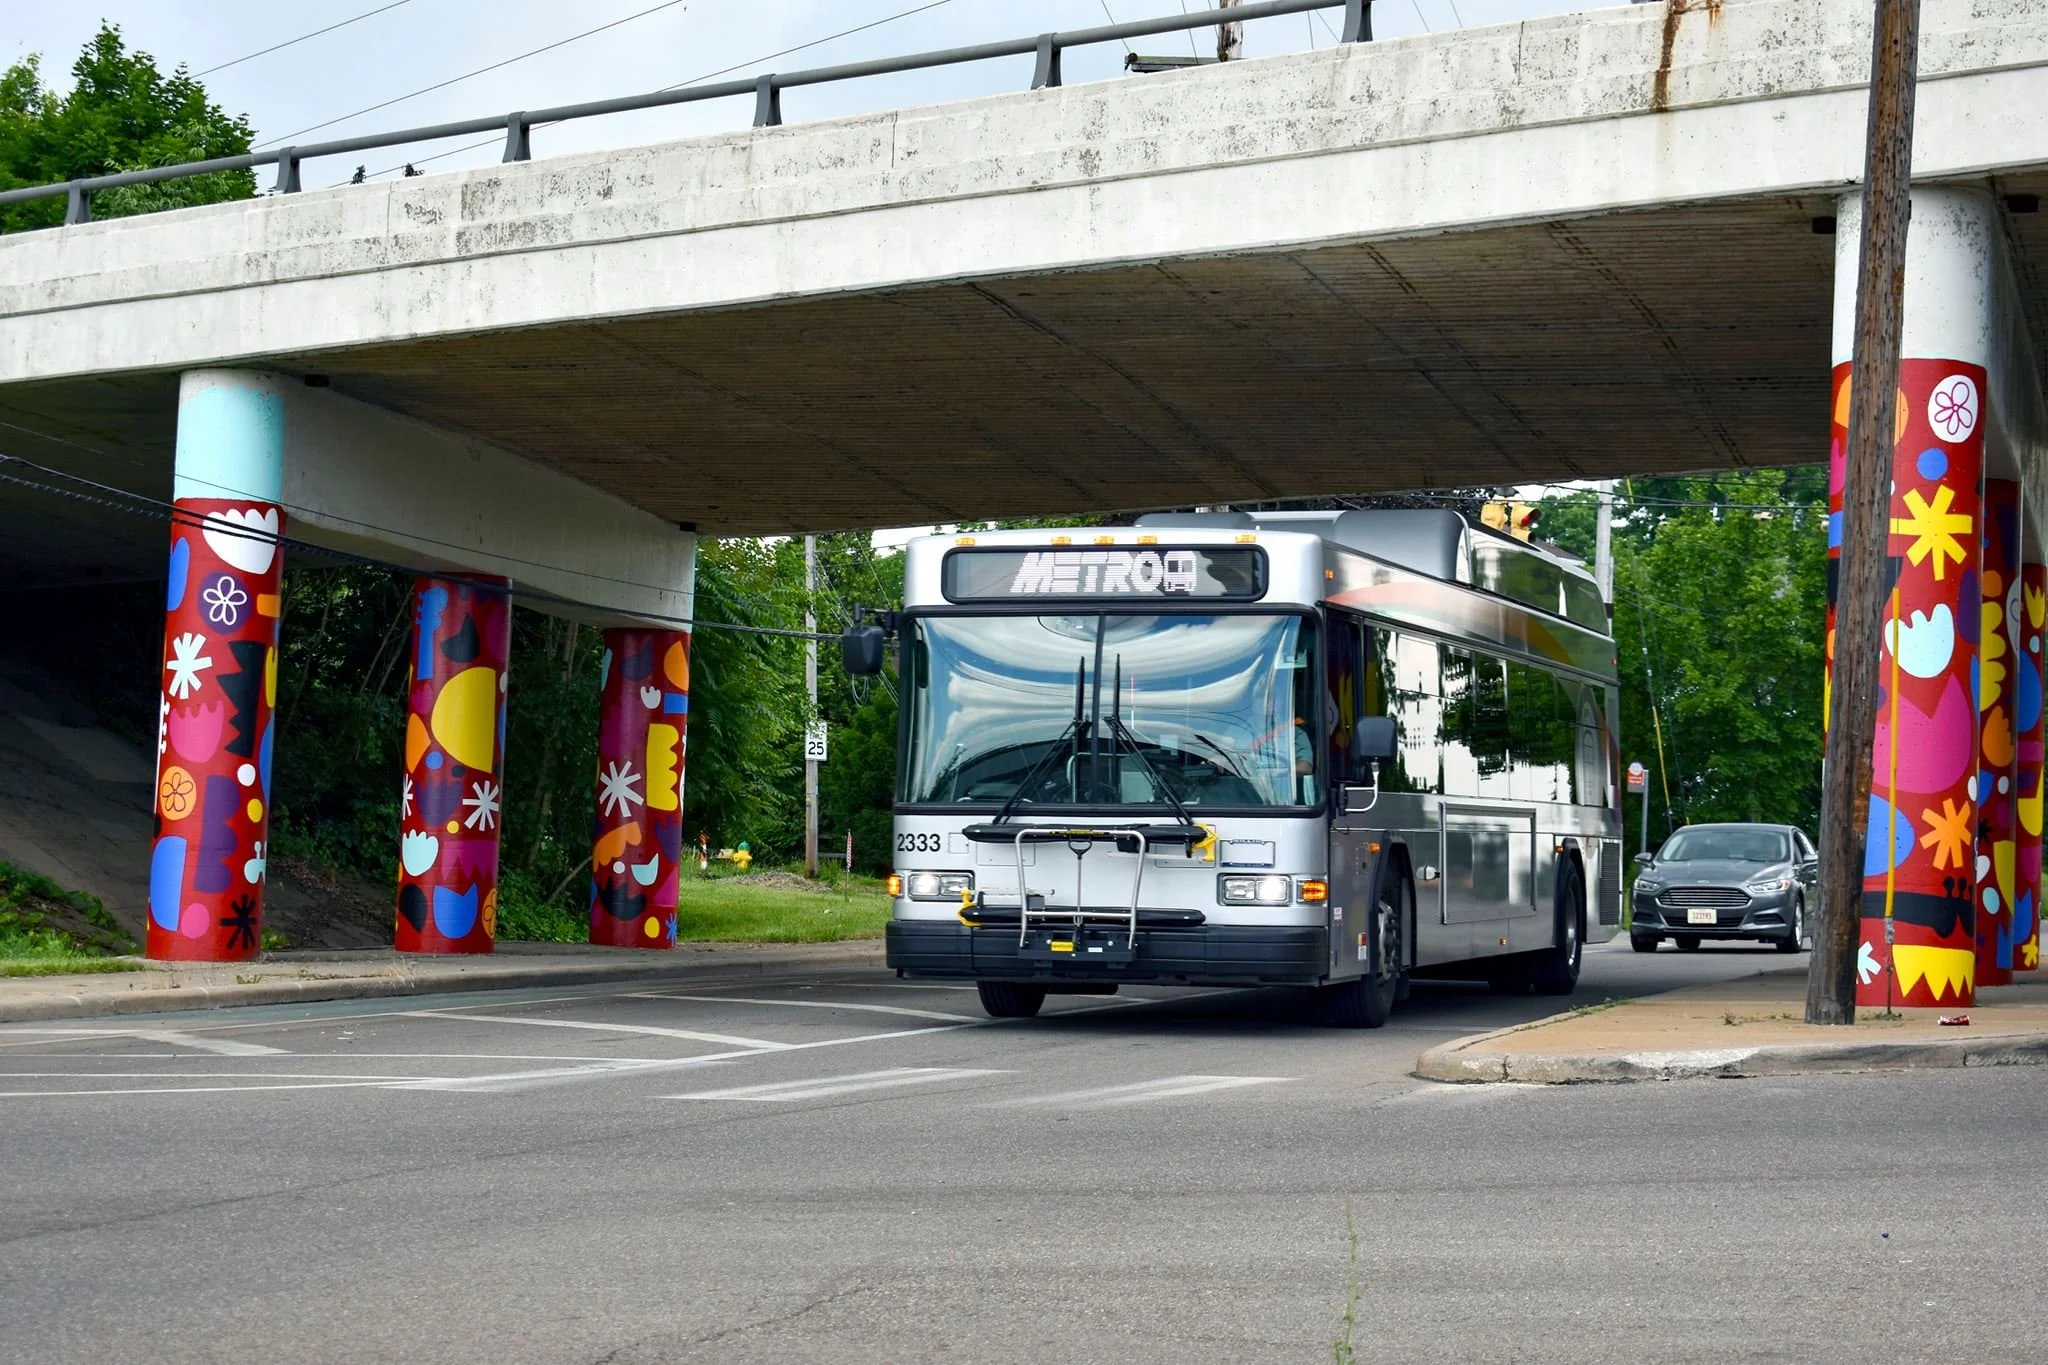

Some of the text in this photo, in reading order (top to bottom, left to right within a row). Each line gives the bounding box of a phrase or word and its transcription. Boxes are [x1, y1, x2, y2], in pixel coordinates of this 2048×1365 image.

[1010, 551, 1163, 592] METRO
[808, 741, 824, 755] 25
[897, 833, 941, 852] 2333
